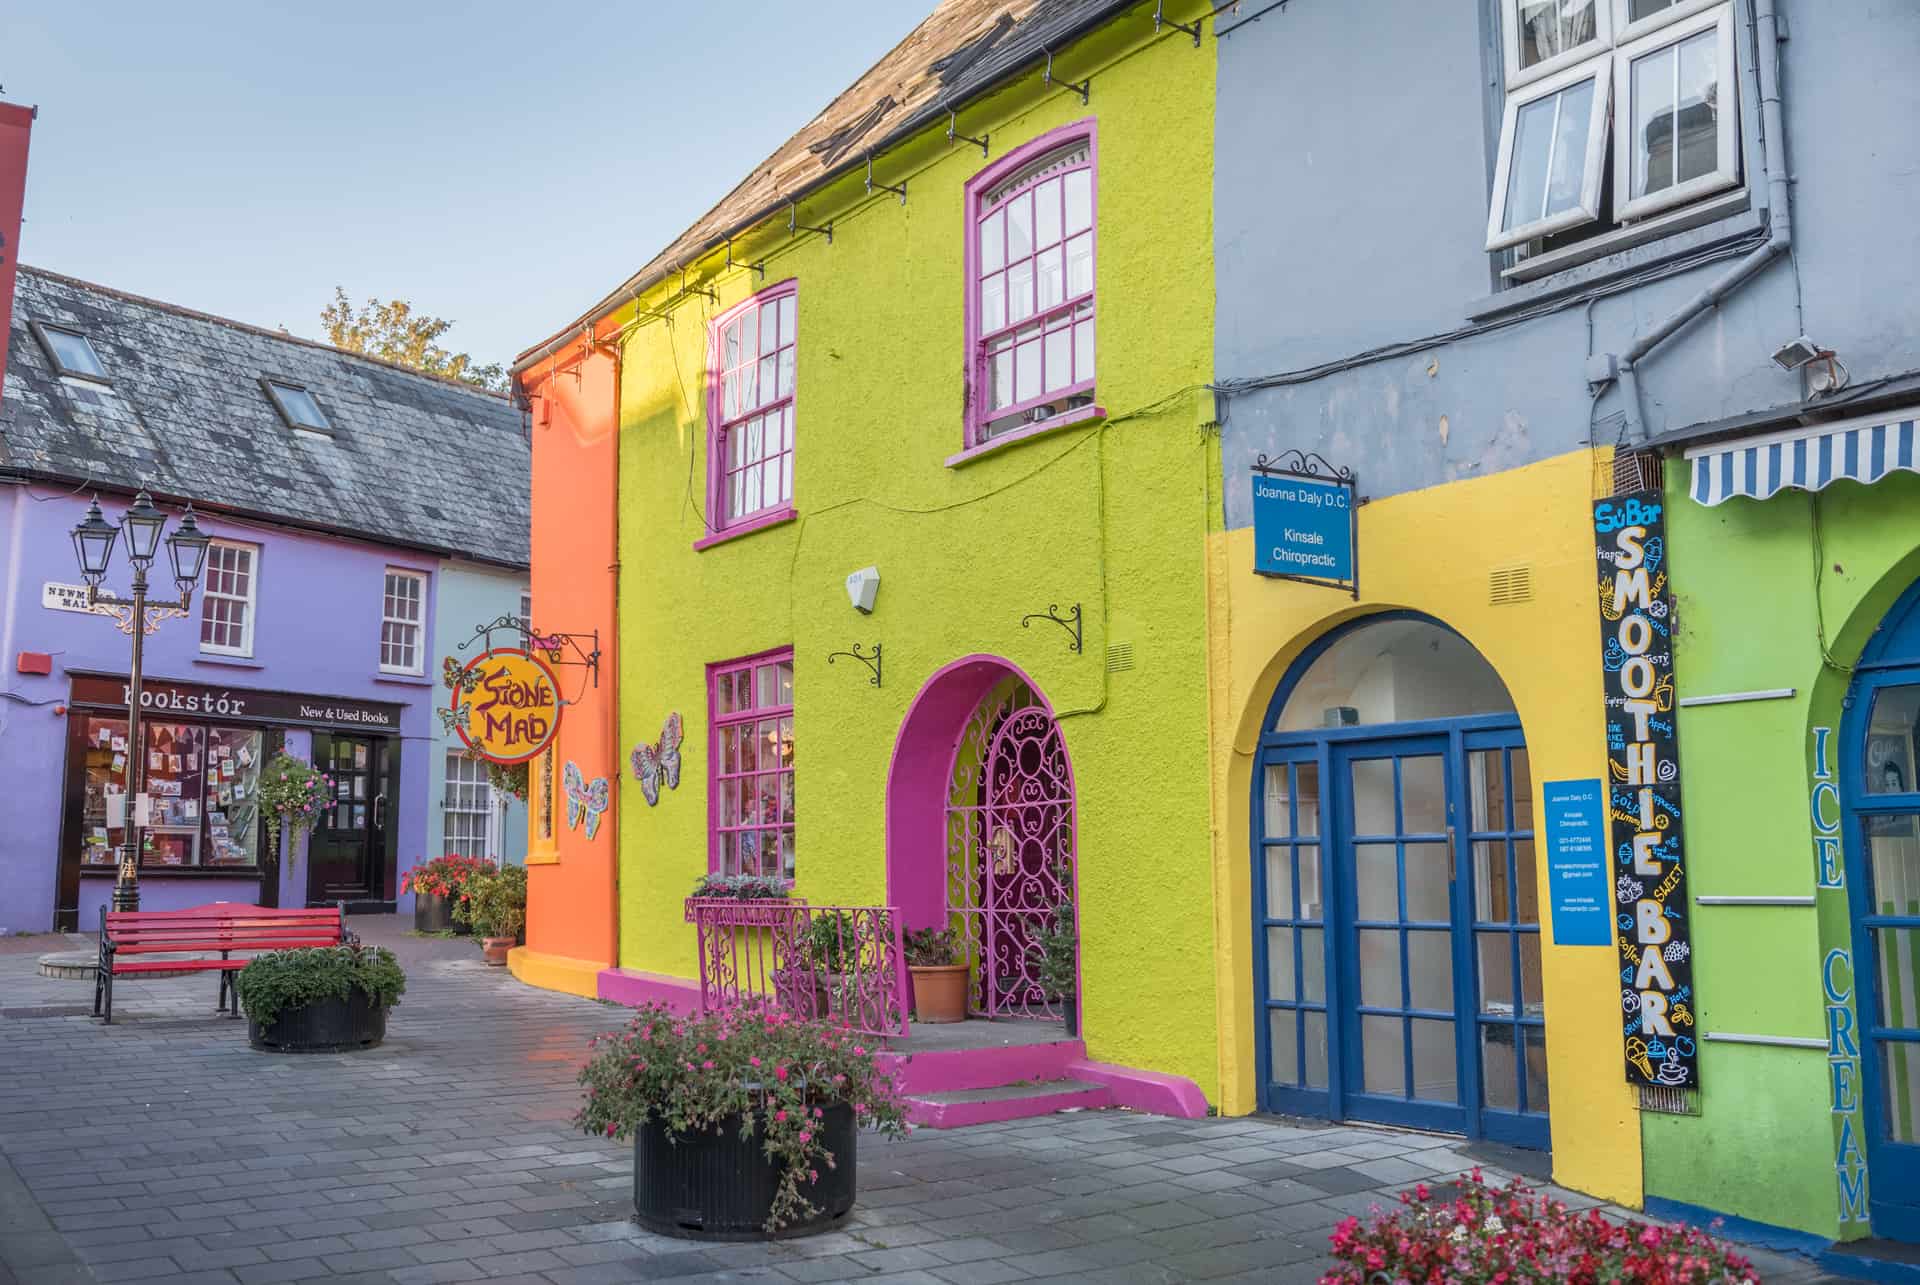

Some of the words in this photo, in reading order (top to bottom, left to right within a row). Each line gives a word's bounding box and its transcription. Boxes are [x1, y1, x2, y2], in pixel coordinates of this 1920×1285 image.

[1256, 484, 1296, 501] Joanna
[1299, 490, 1322, 507] Daly
[1284, 528, 1323, 544] Kinsale
[1273, 547, 1335, 567] Chiropractic
[62, 598, 92, 609] MAL
[123, 685, 245, 715] bookstór
[300, 705, 324, 718] New
[325, 708, 335, 719] &
[336, 709, 359, 721] Used
[362, 711, 388, 724] Books
[1614, 526, 1663, 876] SMOOTHIE
[486, 711, 547, 746] MAD
[1811, 727, 1844, 888] ICE
[1636, 898, 1677, 1036] BAR
[1823, 948, 1870, 1222] CREAM
